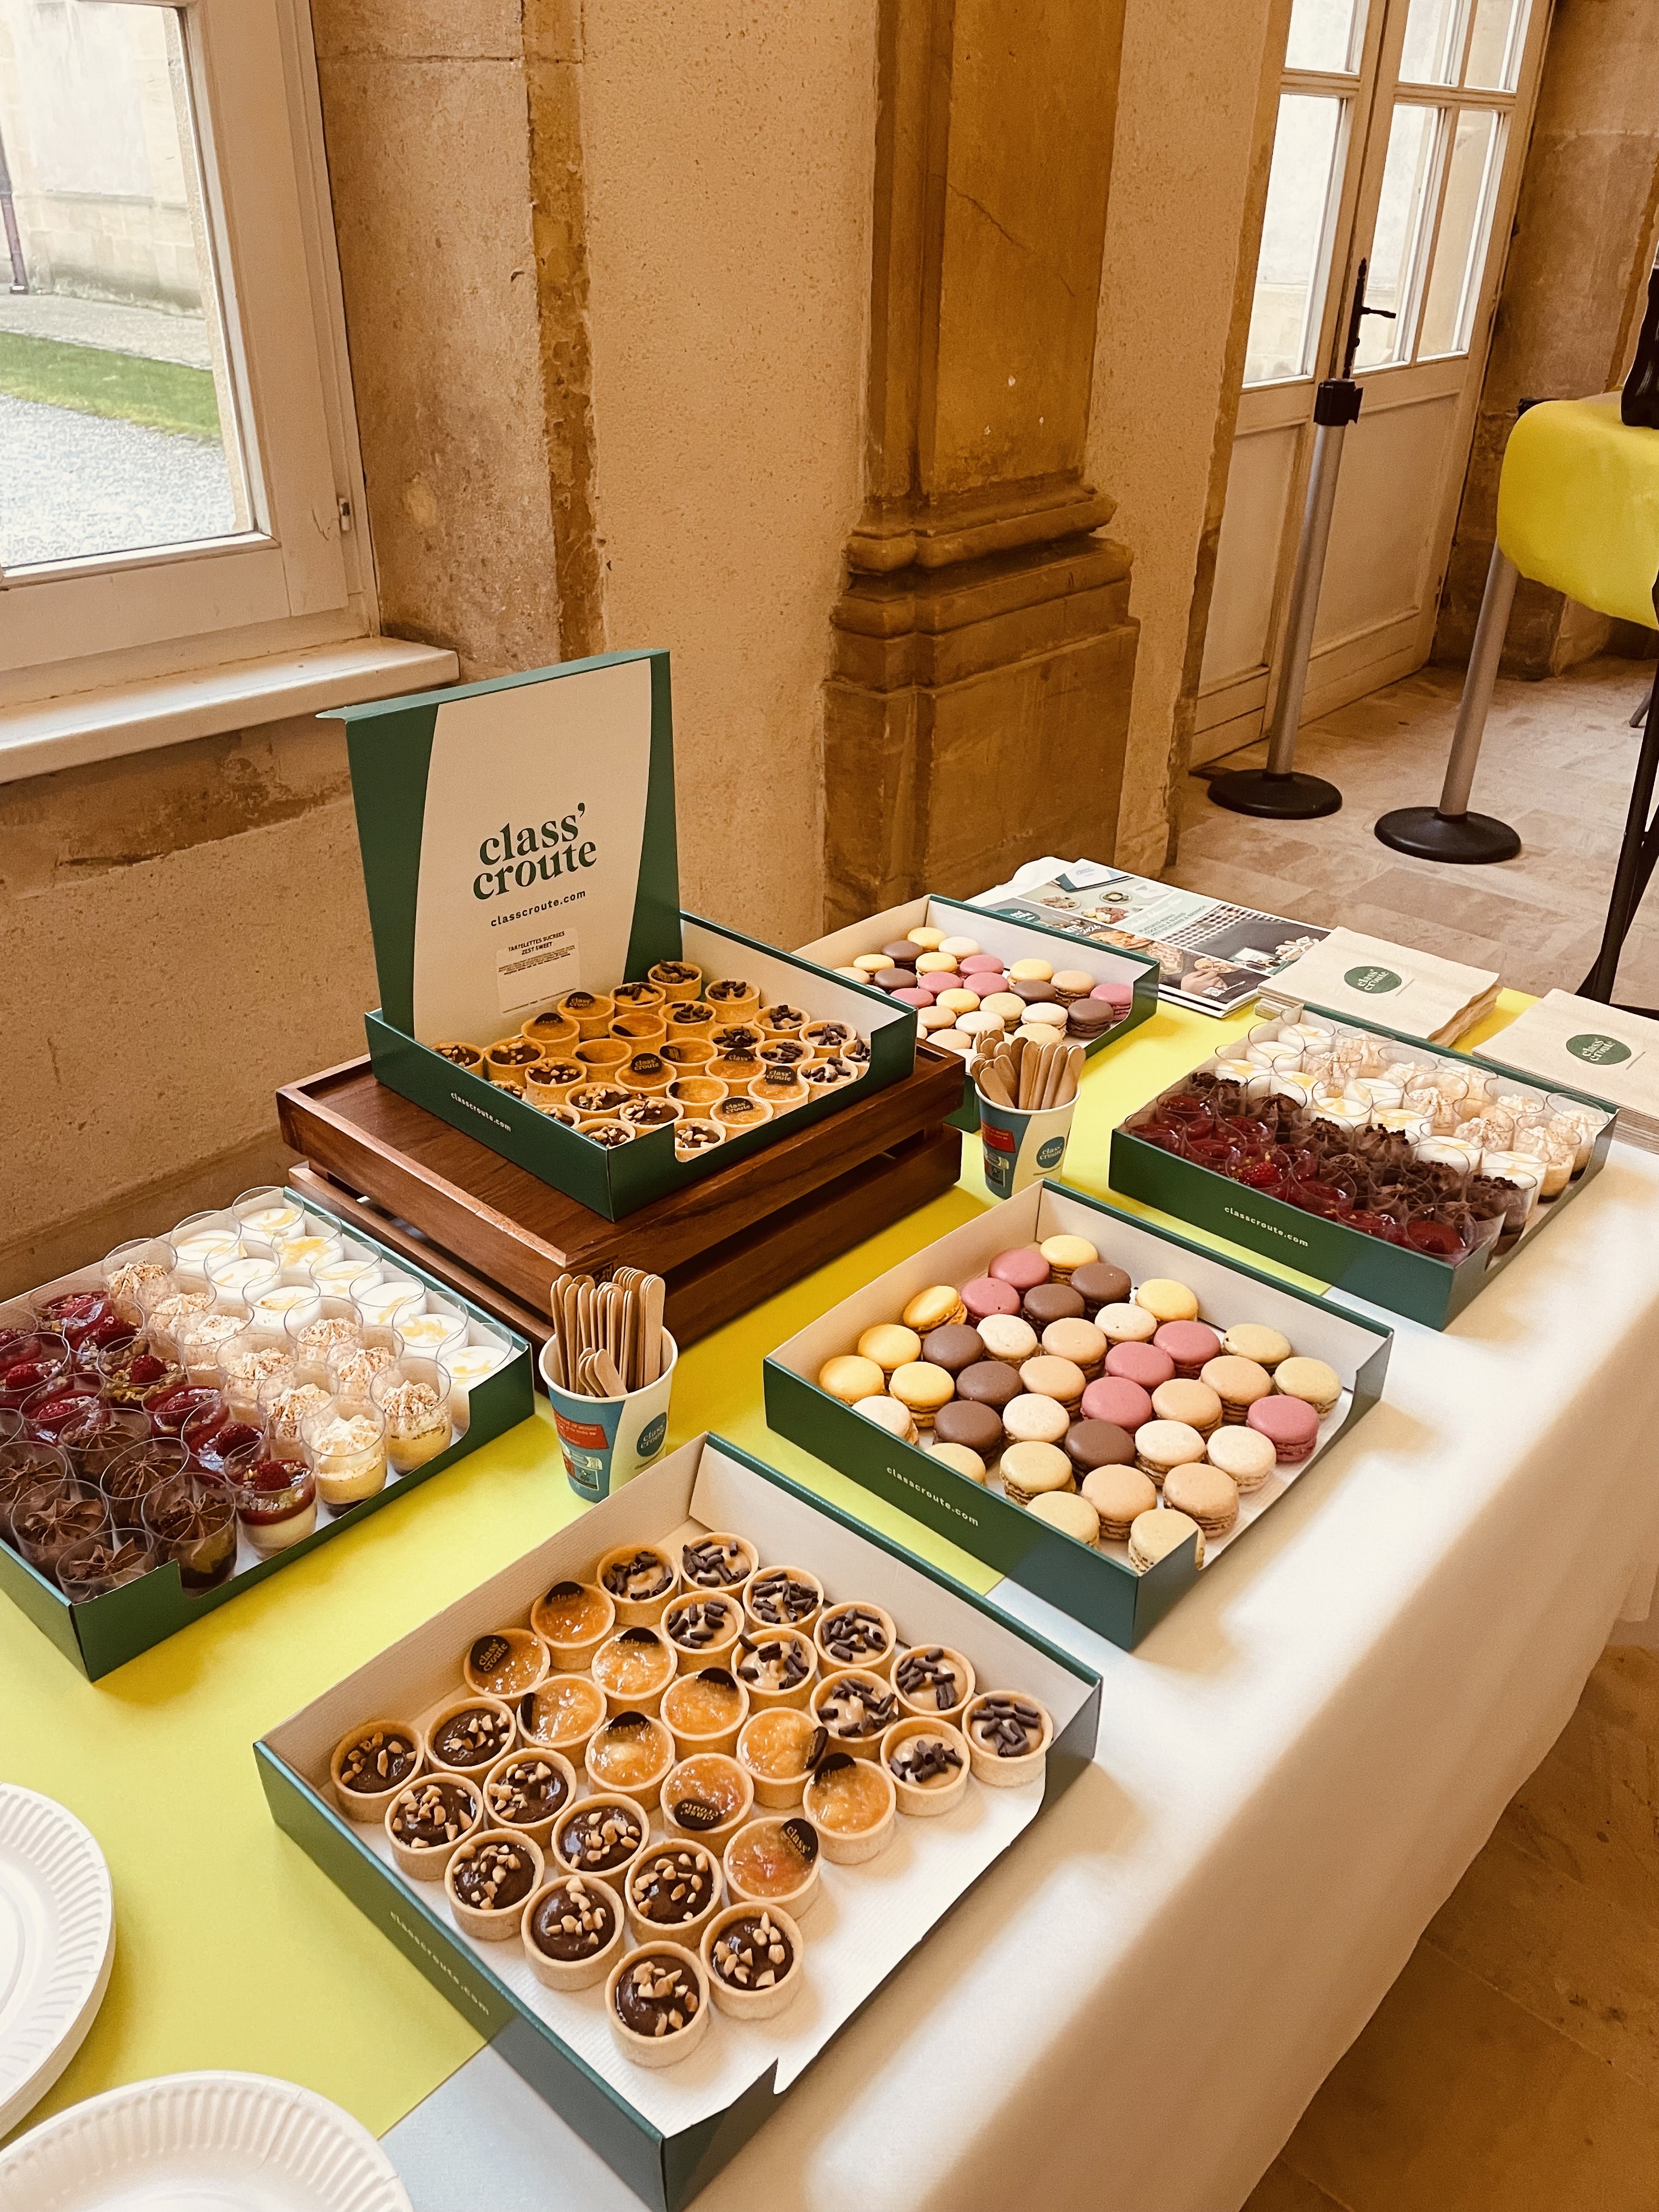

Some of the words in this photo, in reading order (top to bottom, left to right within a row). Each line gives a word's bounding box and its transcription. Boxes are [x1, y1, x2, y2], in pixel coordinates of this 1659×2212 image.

[479, 803, 585, 866] class'
[473, 841, 597, 900] croute
[491, 891, 586, 927] classcroute.com
[508, 938, 542, 952] TARTELETTES
[521, 947, 534, 955] ZEST
[535, 941, 553, 951] SWEET
[451, 1093, 511, 1132] classcroute.com
[1224, 1207, 1308, 1247] classcroute.com
[887, 1466, 979, 1526] classcroute.com
